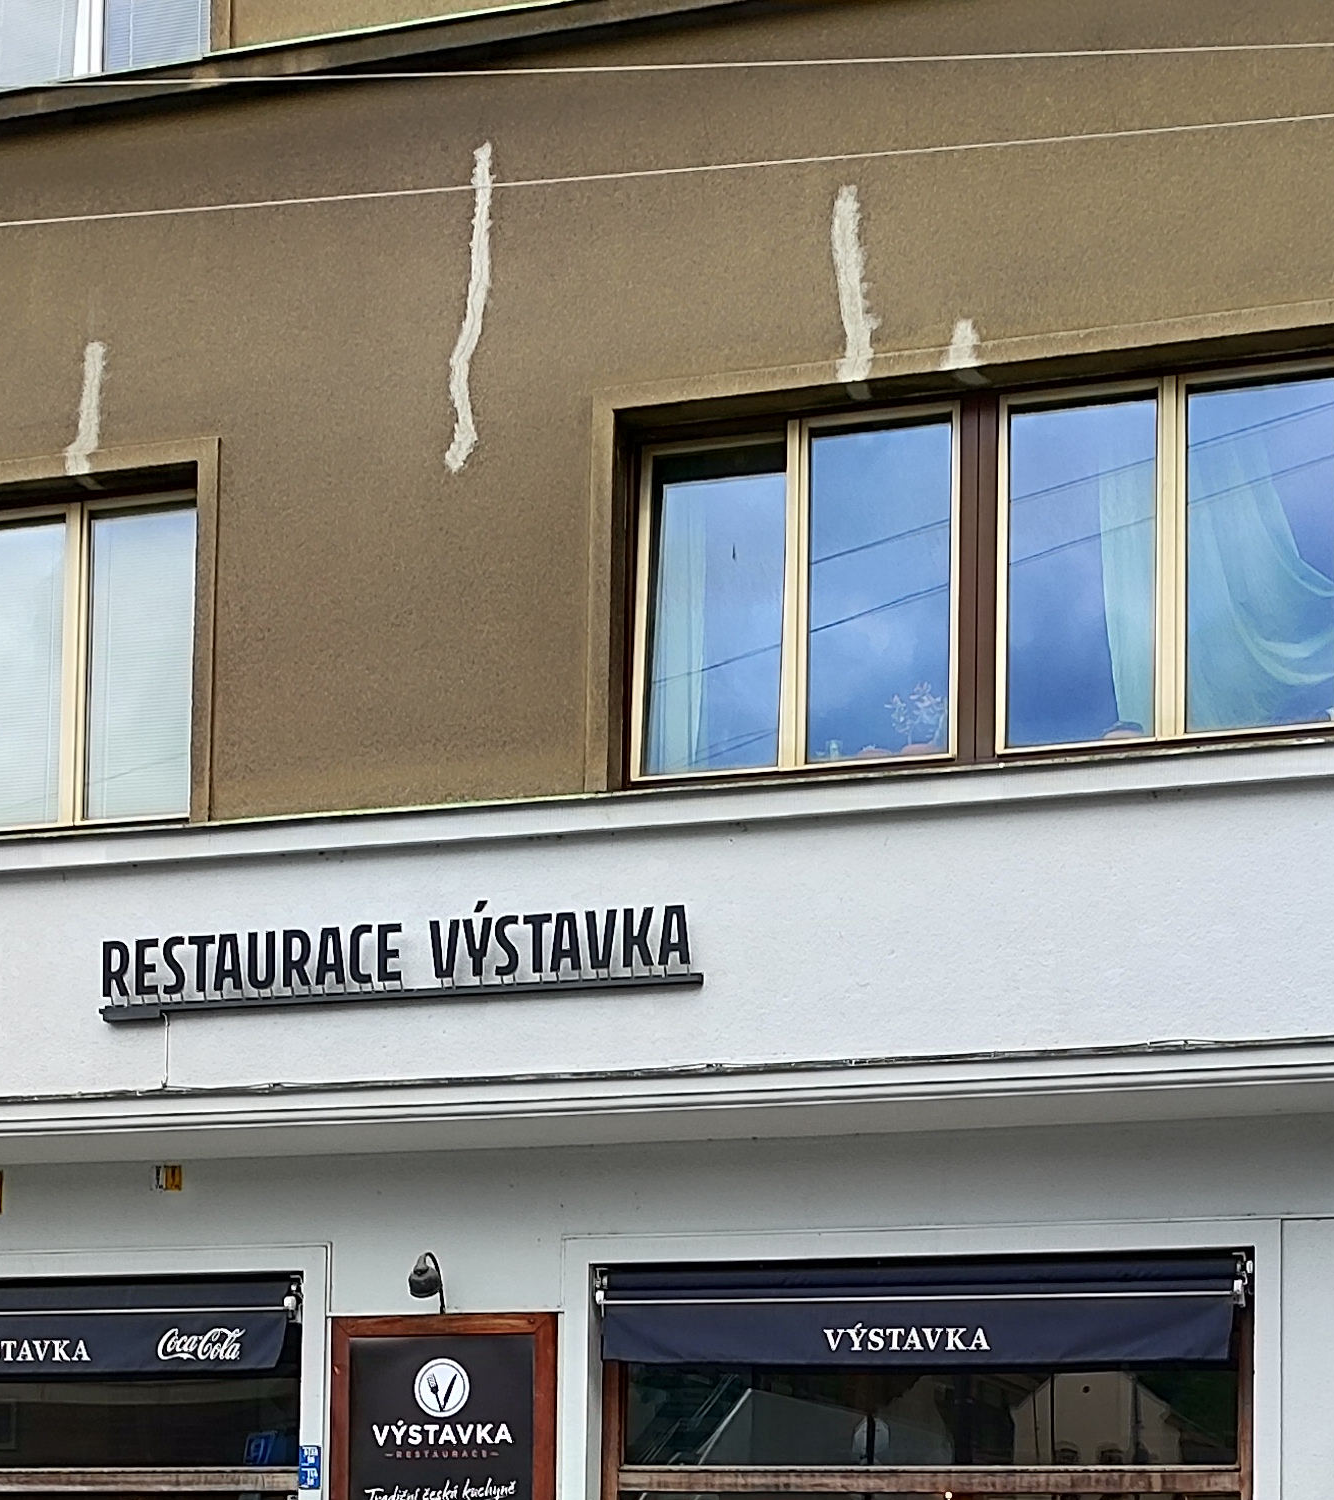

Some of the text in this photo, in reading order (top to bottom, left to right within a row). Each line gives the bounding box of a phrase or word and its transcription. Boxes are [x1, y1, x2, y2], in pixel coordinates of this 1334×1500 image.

[101, 900, 692, 998] RESTAURACE VÝSTAVKA
[157, 1327, 246, 1360] Coca-Cola
[823, 1323, 990, 1352] VÝSTAVKA
[372, 1420, 513, 1446] VÝSTAVKA
[395, 1450, 488, 1459] RESTAURACE
